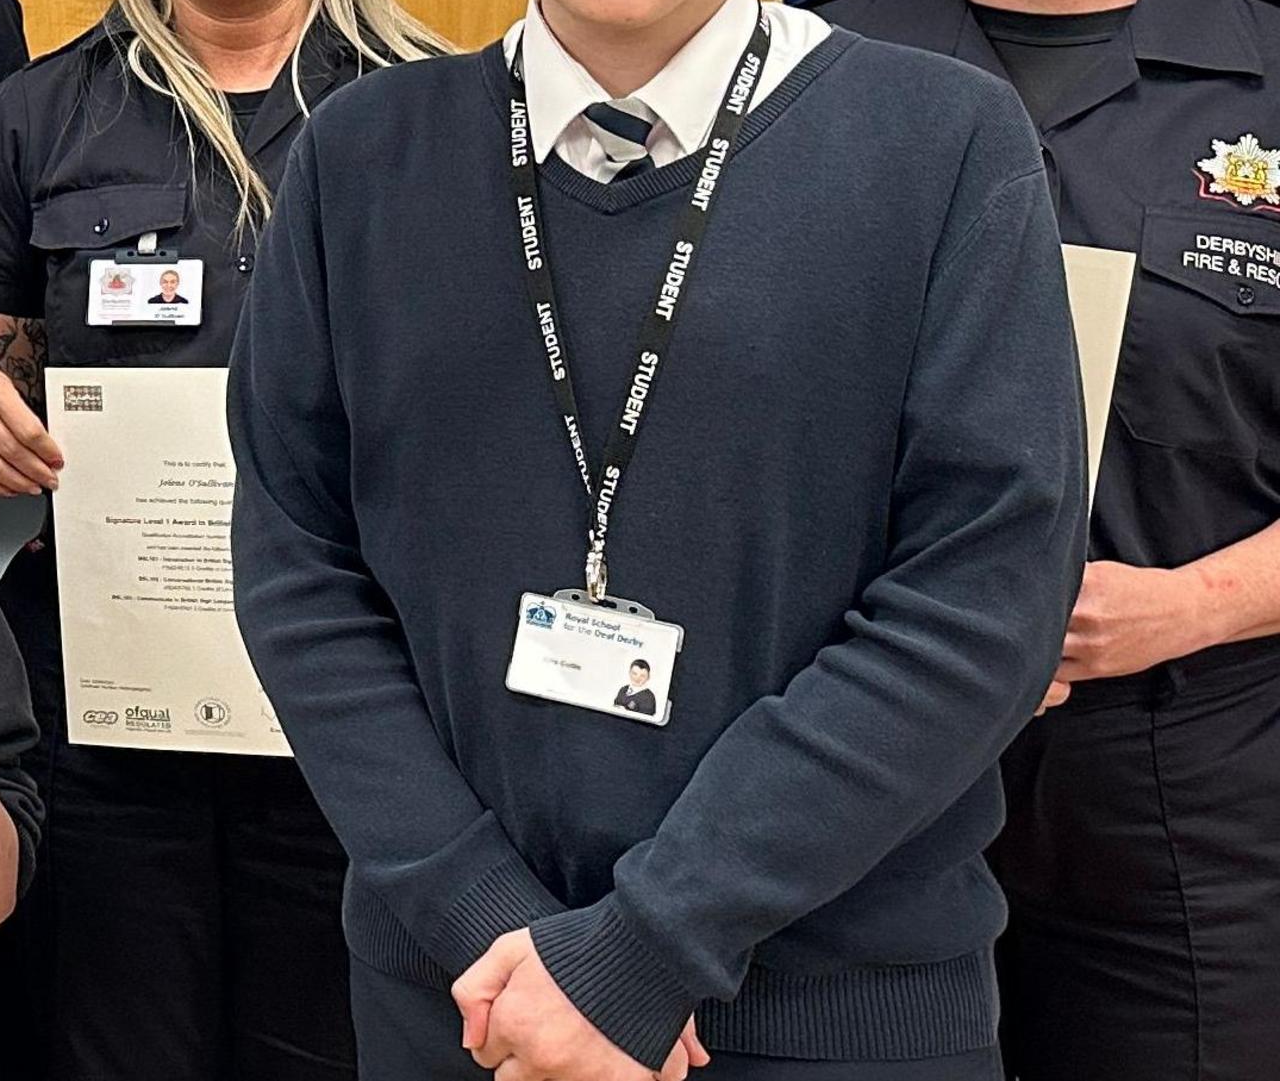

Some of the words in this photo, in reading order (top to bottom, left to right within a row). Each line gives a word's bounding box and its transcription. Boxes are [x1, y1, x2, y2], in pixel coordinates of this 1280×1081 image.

[726, 52, 761, 116] STUDENT
[510, 99, 528, 168] STUDENT
[691, 137, 730, 213] STUDENT
[517, 195, 543, 271] STUDENT
[1183, 251, 1225, 273] FIRE
[1227, 258, 1243, 276] &
[655, 239, 694, 321] STUDENT
[536, 302, 566, 381] STUDENT
[619, 350, 659, 436] STUDENT
[125, 706, 170, 720] ofqual
